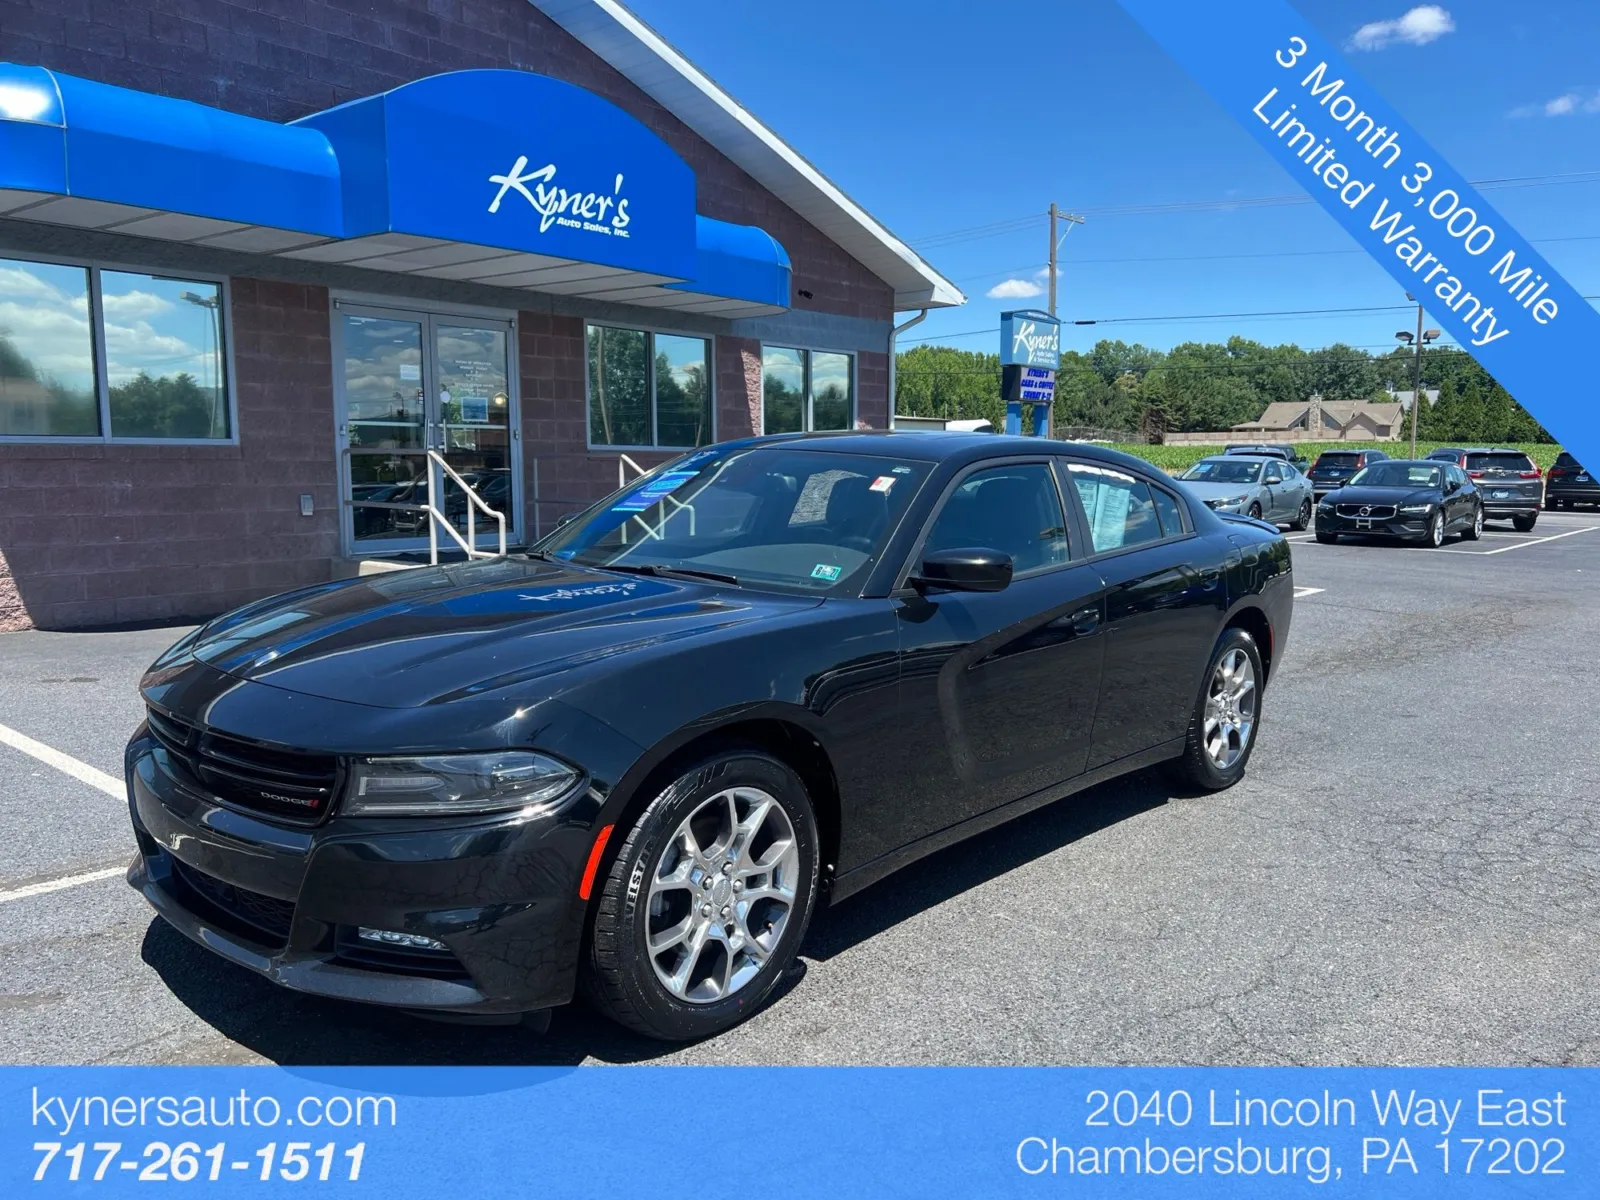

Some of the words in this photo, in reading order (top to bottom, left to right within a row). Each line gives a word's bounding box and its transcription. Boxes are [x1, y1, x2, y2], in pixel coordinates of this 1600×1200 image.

[488, 155, 631, 233] Kyner's
[556, 216, 582, 229] Auto
[583, 222, 612, 235] Sales,
[613, 227, 631, 238] Inc.
[1014, 321, 1058, 364] Kyner's
[260, 791, 311, 807] DODGE
